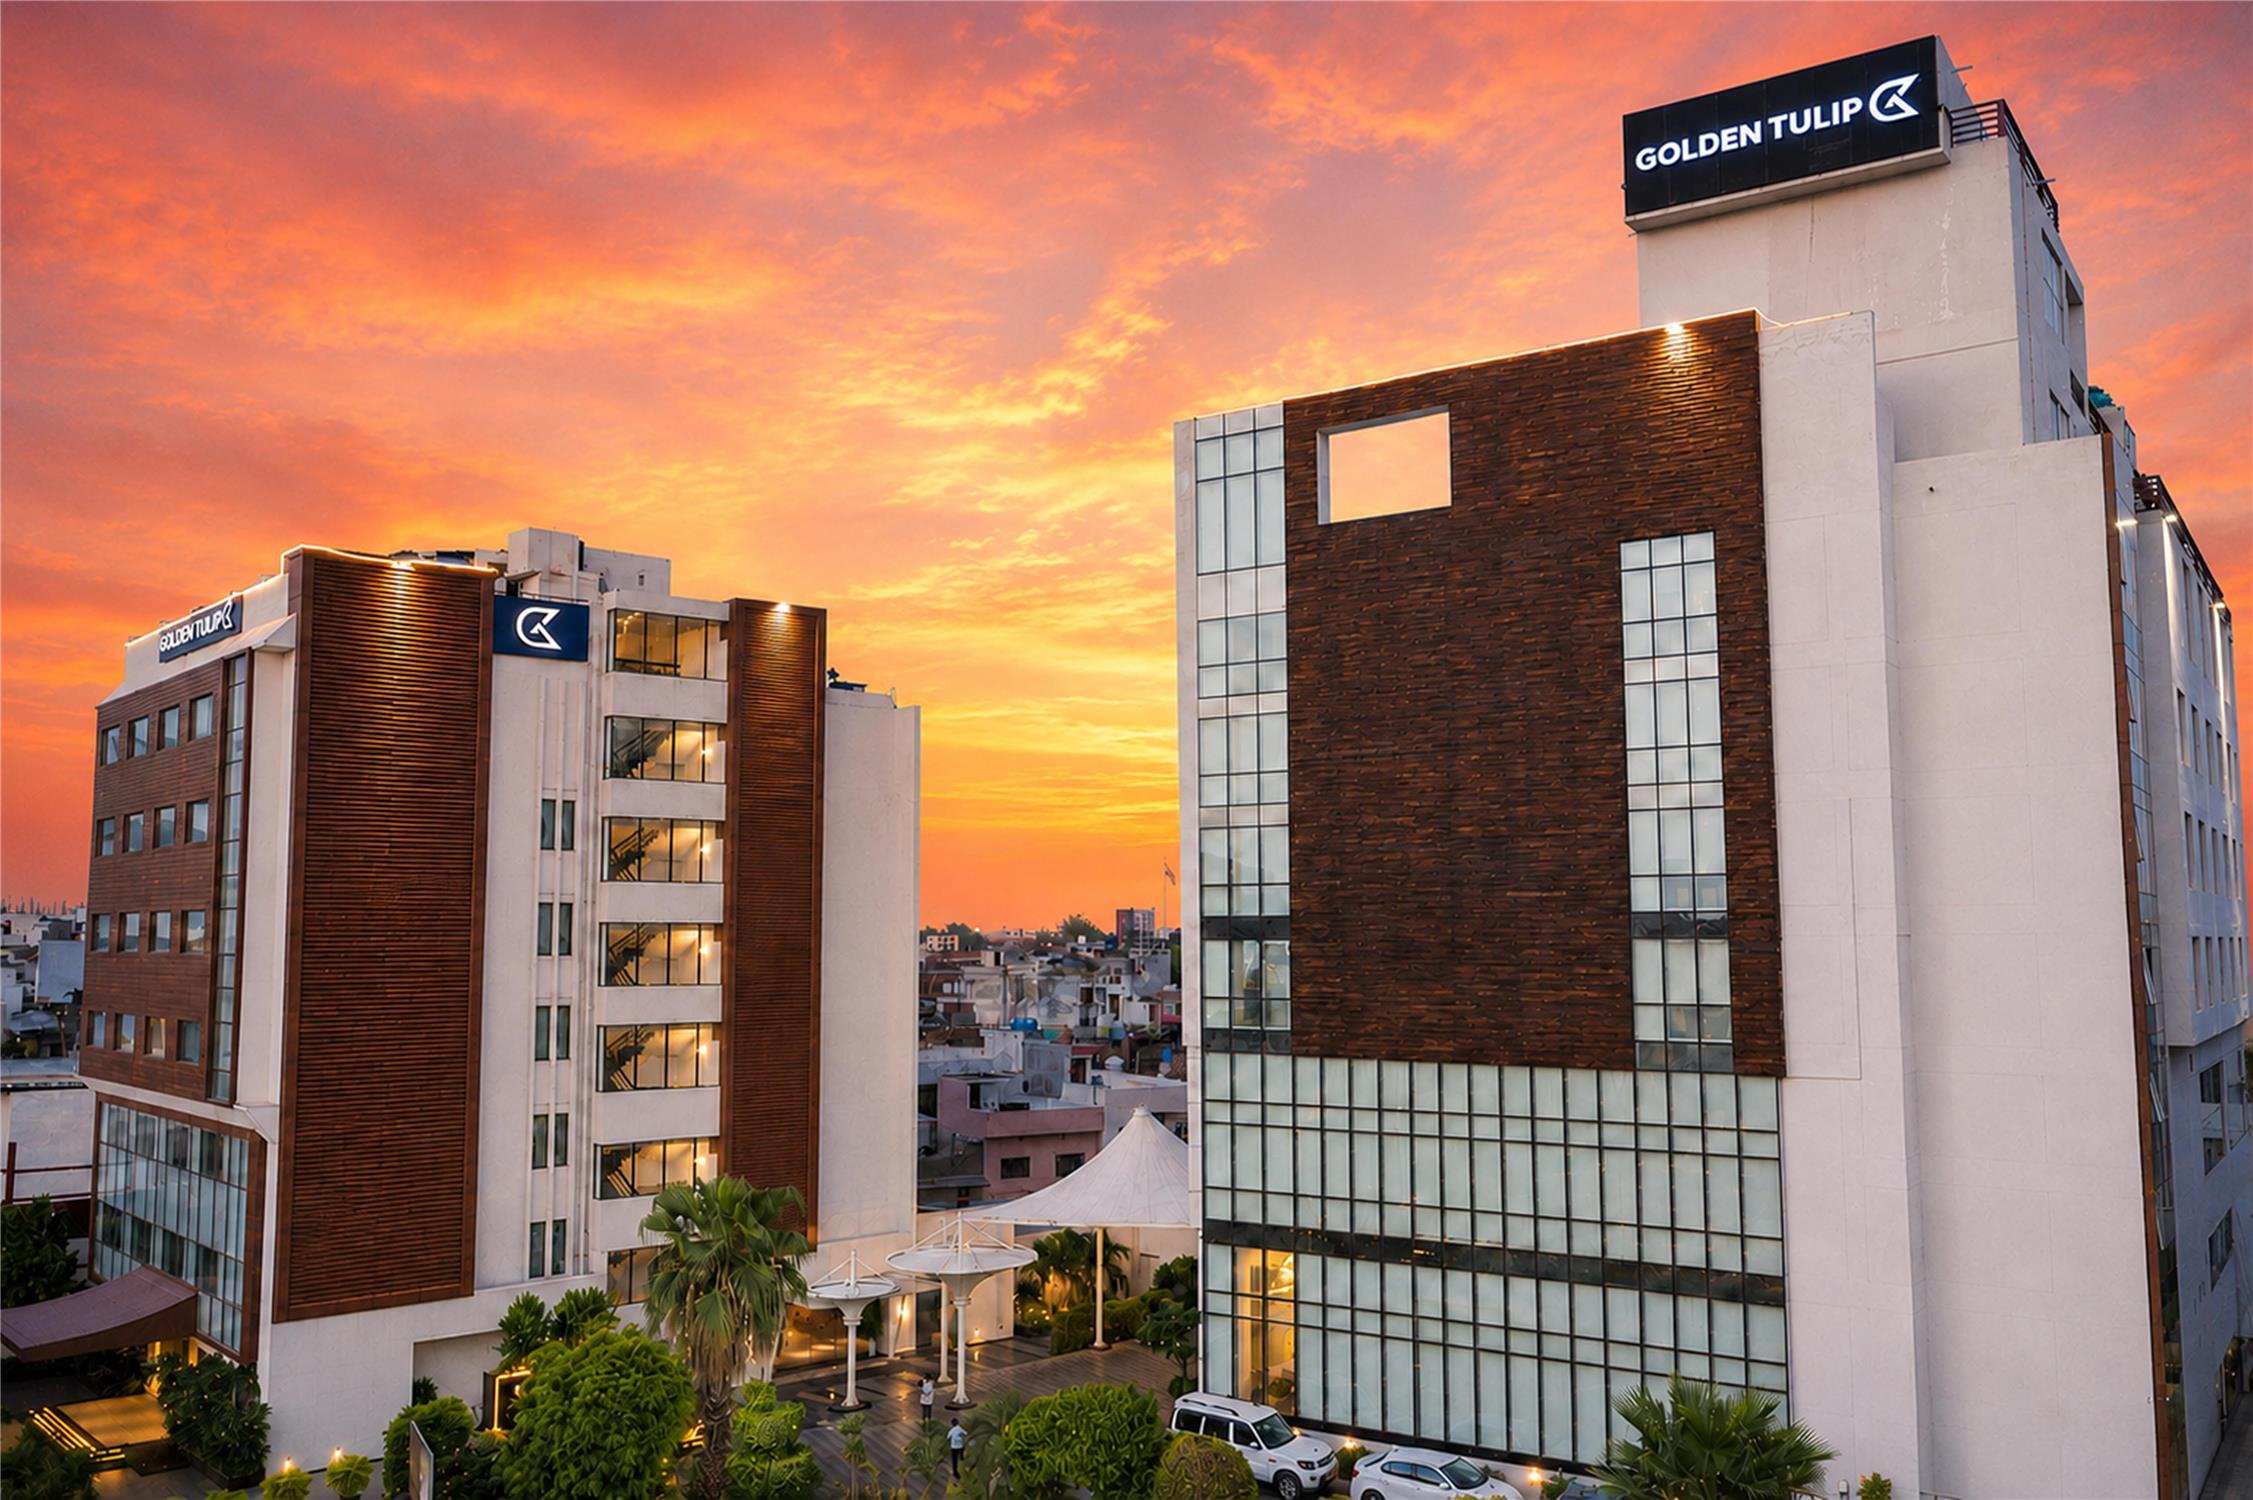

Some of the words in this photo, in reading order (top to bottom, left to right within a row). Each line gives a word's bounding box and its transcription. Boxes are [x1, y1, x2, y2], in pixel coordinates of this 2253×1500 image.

[1635, 121, 1762, 171] GOLDEN
[1768, 96, 1863, 140] TULIP
[159, 622, 195, 652] GOLDEN
[195, 610, 223, 638] TULIP
